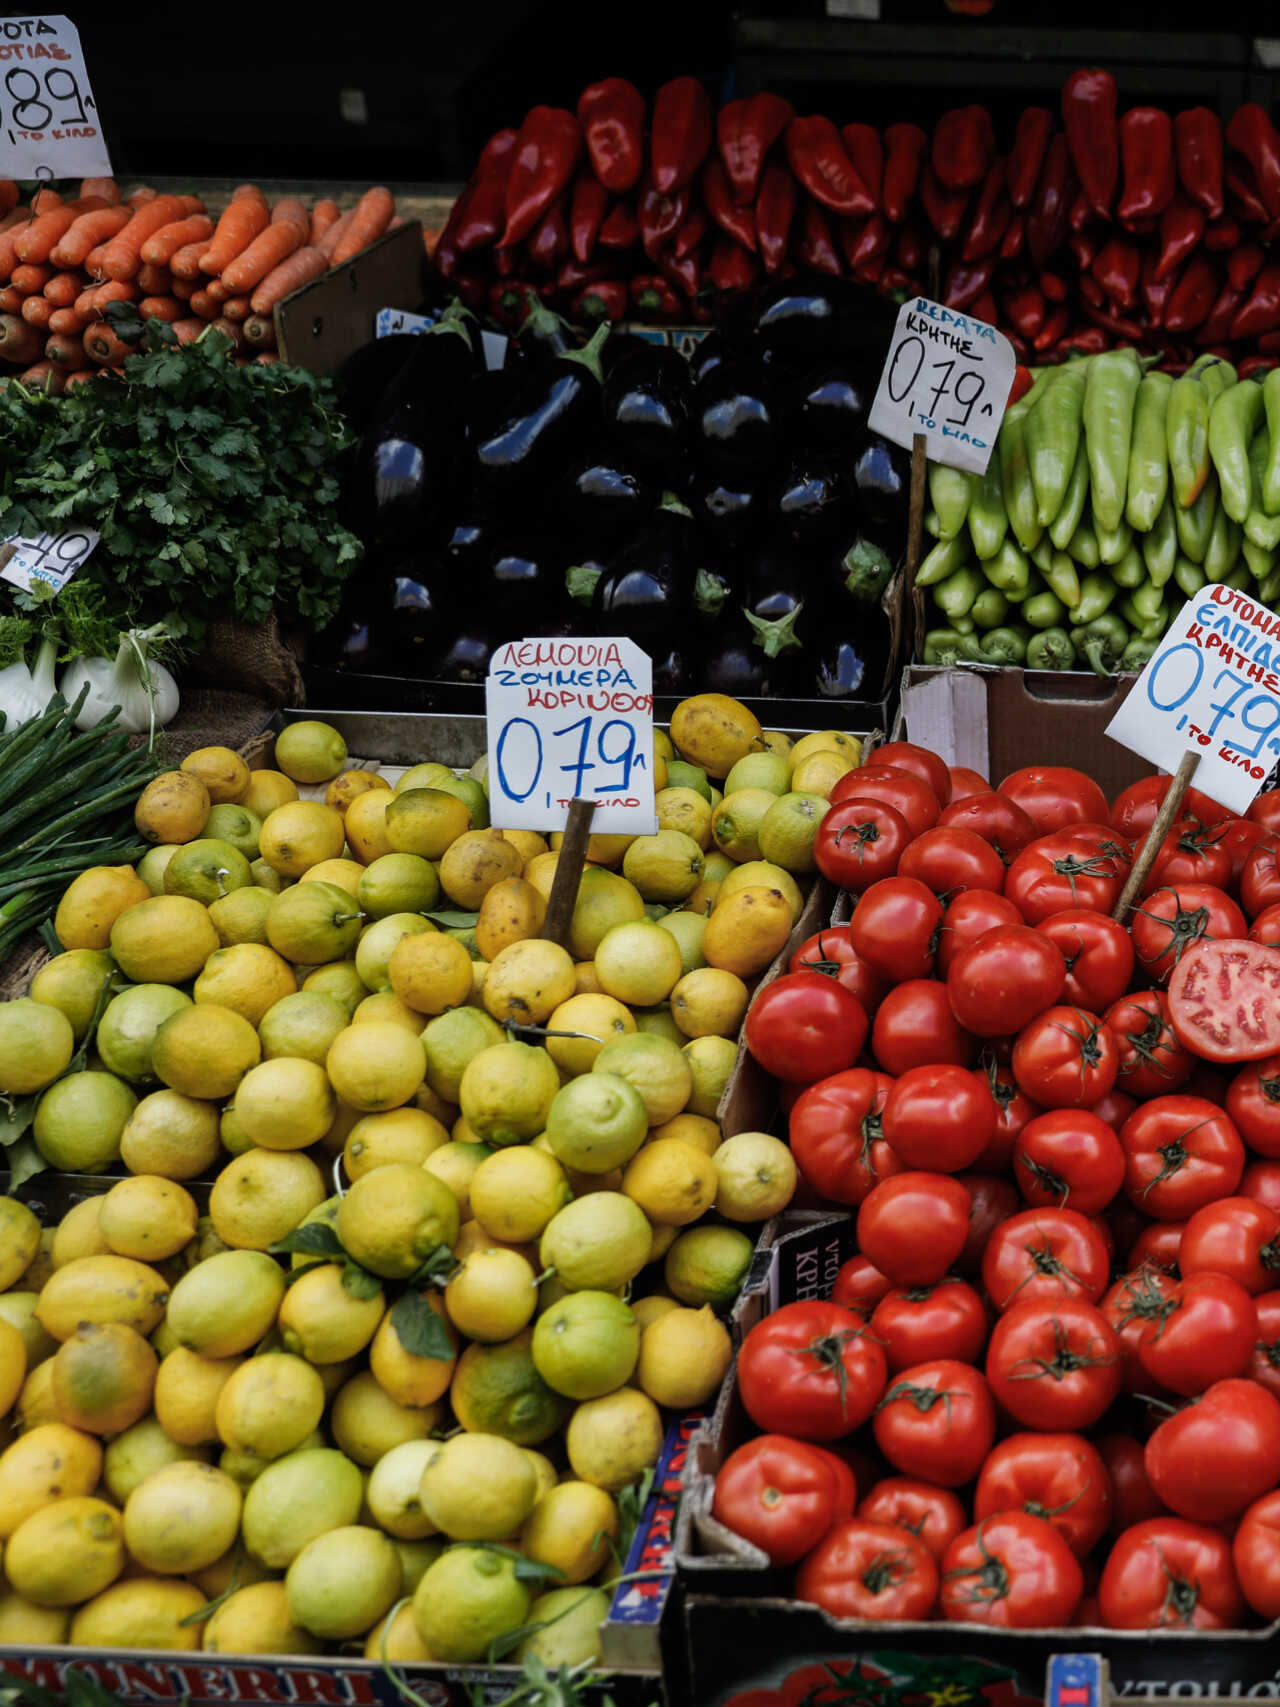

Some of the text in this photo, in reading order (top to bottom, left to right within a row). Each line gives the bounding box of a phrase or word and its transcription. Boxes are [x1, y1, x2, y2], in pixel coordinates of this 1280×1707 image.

[0, 19, 57, 40] ΟΤΑ
[0, 67, 88, 145] ,89
[906, 312, 983, 361] ΚΡΗΤΗΣ
[918, 413, 987, 448] ΤΟ ΚΙΛΟ
[504, 643, 623, 668] ΛΕΜΟΝΙΑ
[1186, 622, 1280, 696] ΚΡΗΤΗΣ
[494, 669, 637, 689] ΖΟΥΜΕΡΑ
[1189, 724, 1265, 779] ΤΟ ΚΙΛΟ
